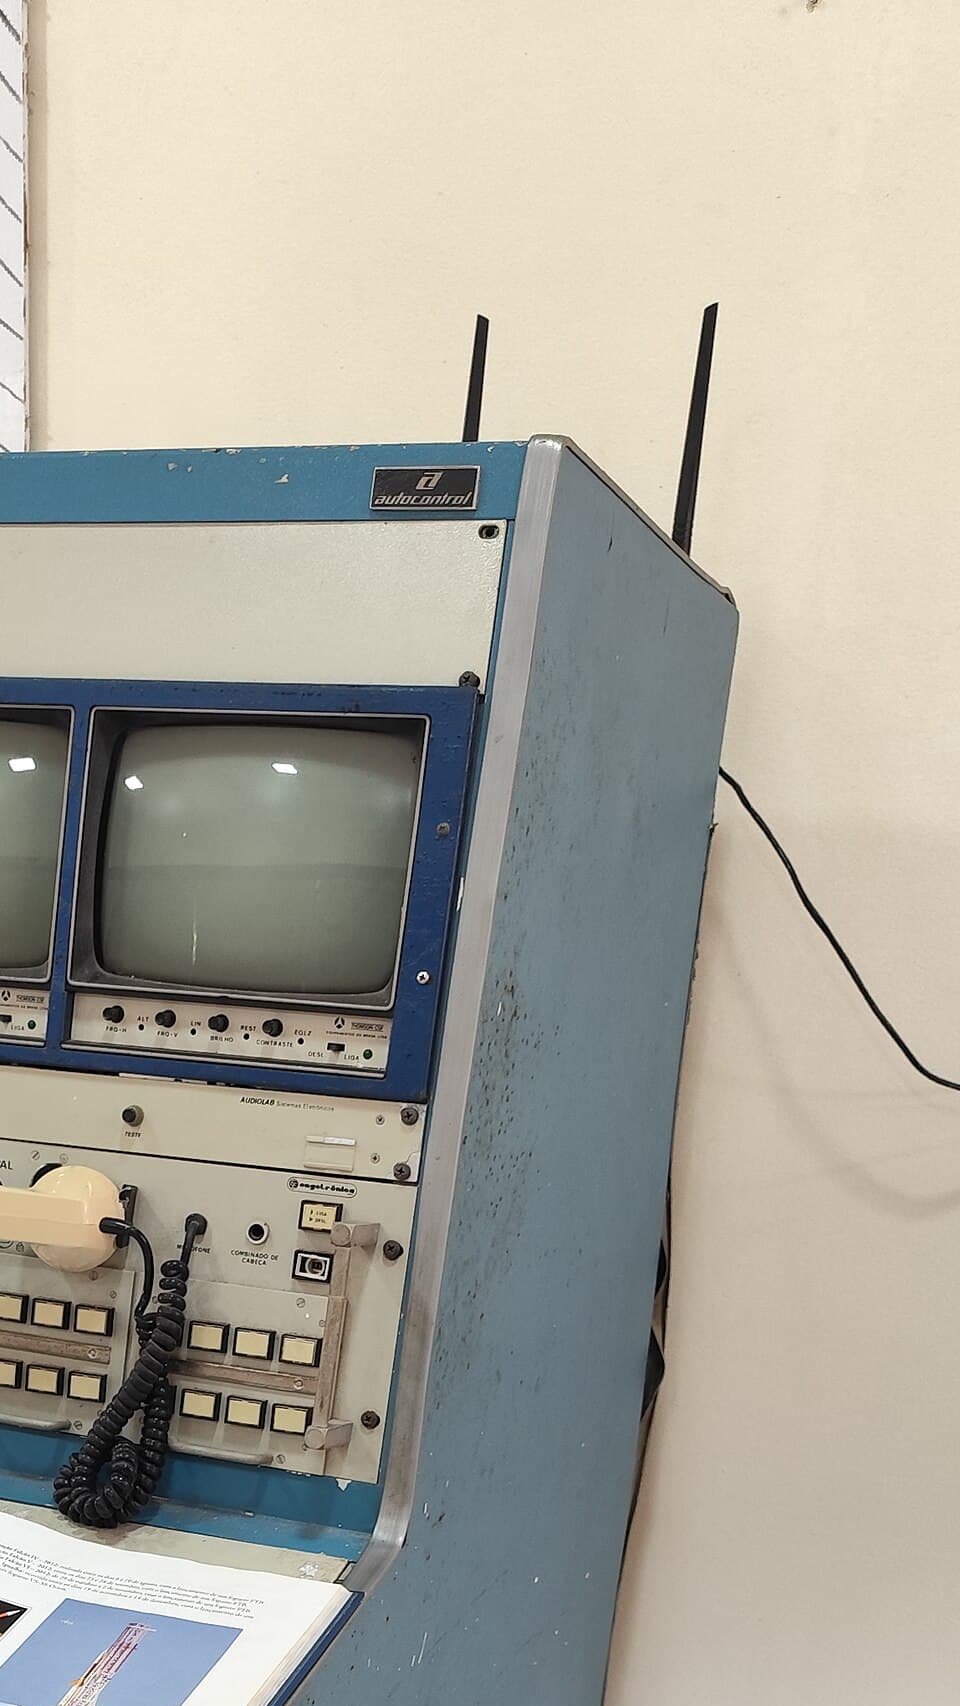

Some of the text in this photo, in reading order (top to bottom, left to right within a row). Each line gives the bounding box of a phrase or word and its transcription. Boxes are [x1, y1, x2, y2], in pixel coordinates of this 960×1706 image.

[374, 491, 472, 505] autocontrol
[256, 1039, 293, 1048] CONTRASTE
[240, 1096, 275, 1106] AUDIOLAB
[176, 1244, 211, 1254] MOFONE
[230, 1249, 269, 1259] COMBINADO
